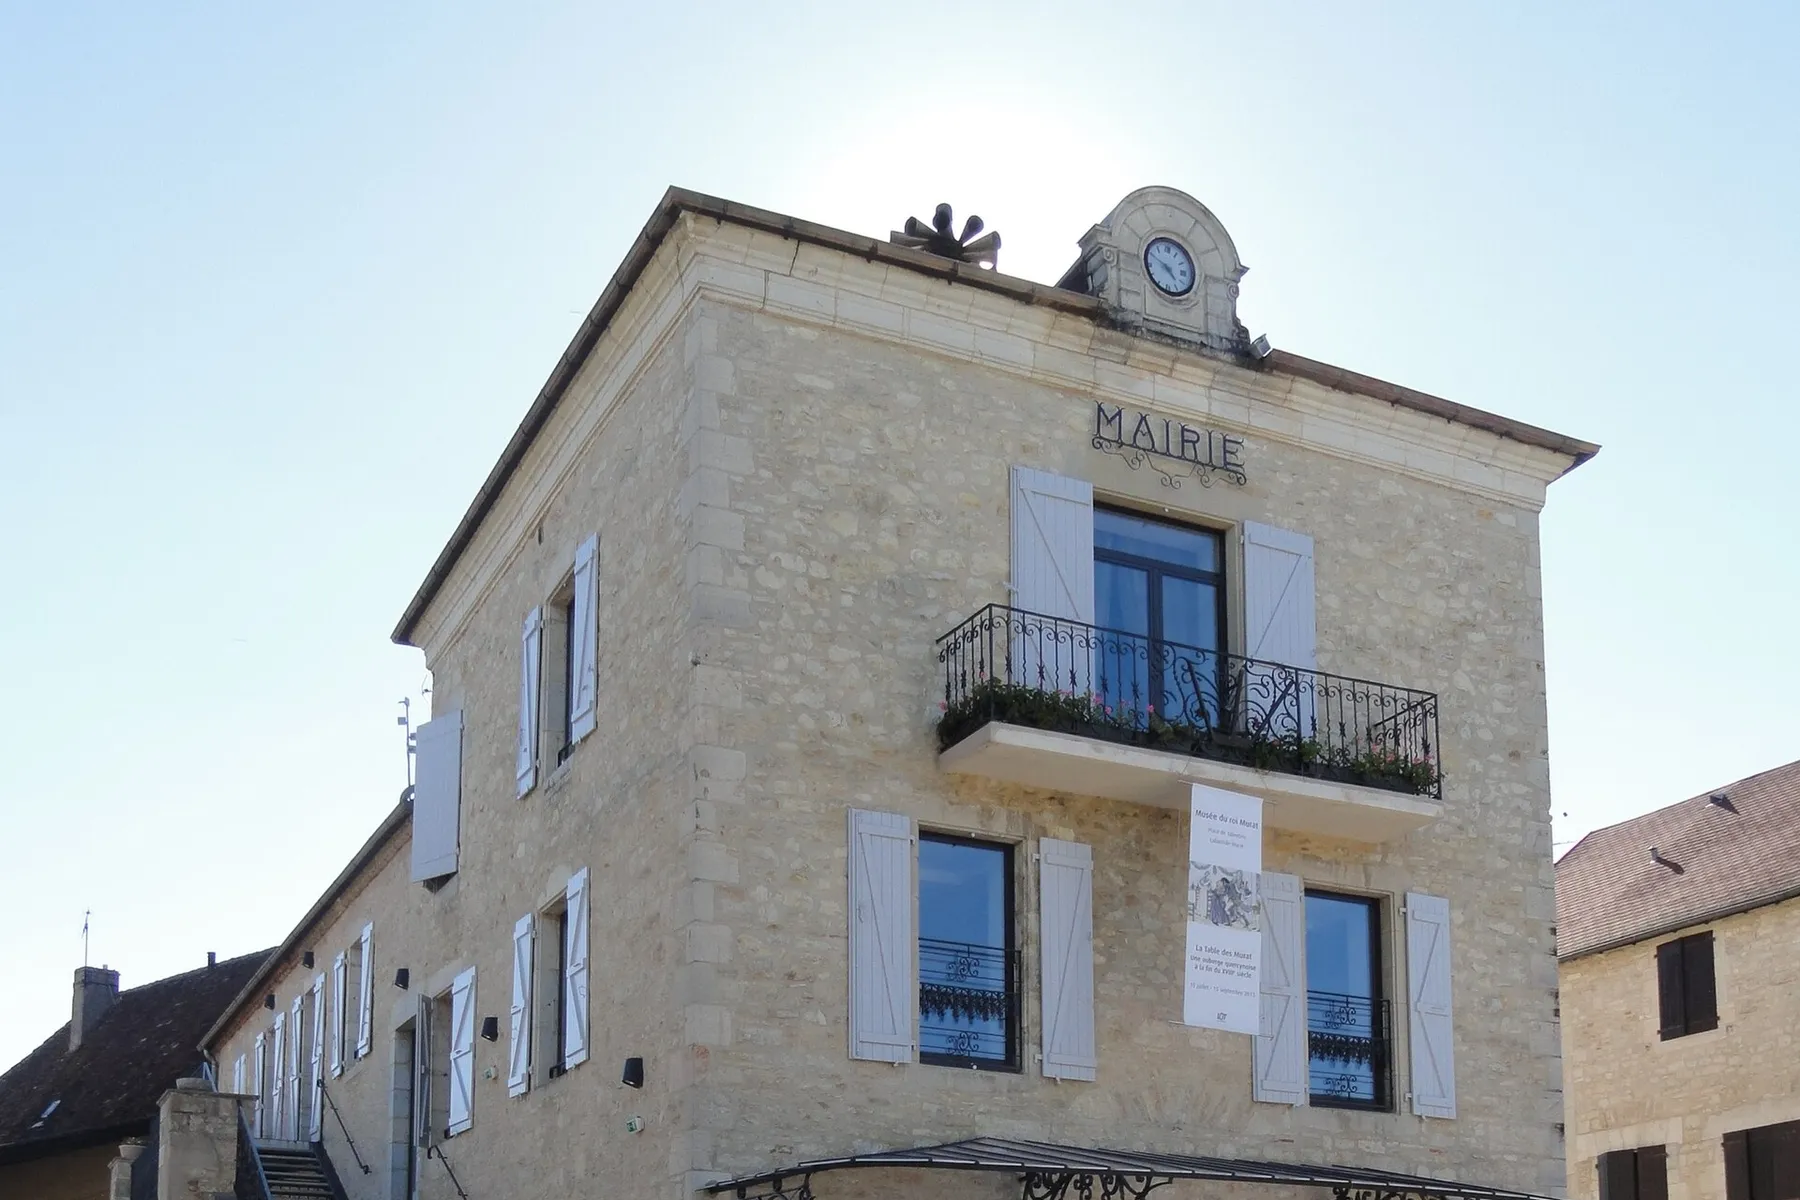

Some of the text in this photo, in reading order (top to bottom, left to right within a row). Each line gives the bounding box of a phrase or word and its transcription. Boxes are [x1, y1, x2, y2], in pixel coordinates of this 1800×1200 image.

[1095, 400, 1246, 471] MAIRIE
[1195, 809, 1259, 830] Musée du roi Murat
[1195, 944, 1253, 960] La Table des Murat
[1213, 966, 1221, 974] du
